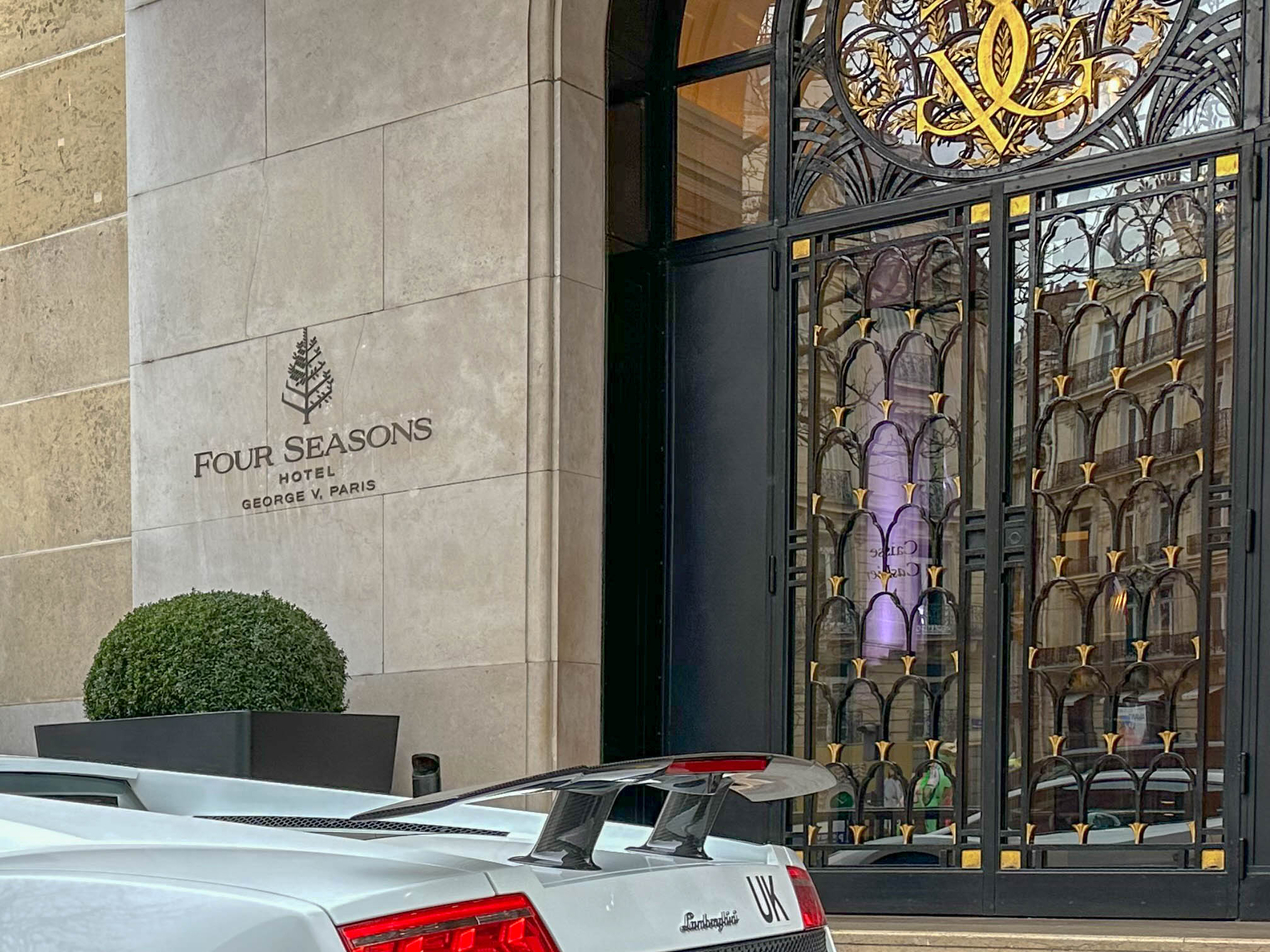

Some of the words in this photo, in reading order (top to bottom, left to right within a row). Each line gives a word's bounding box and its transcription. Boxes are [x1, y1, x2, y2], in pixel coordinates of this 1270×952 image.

[193, 445, 274, 478] FOUR
[283, 417, 433, 463] SEASONS
[279, 466, 336, 485] HOTEL
[241, 490, 305, 510] GEORGE
[329, 479, 376, 497] PARIS
[746, 875, 790, 924] UK
[679, 910, 740, 933] Lamborghini
